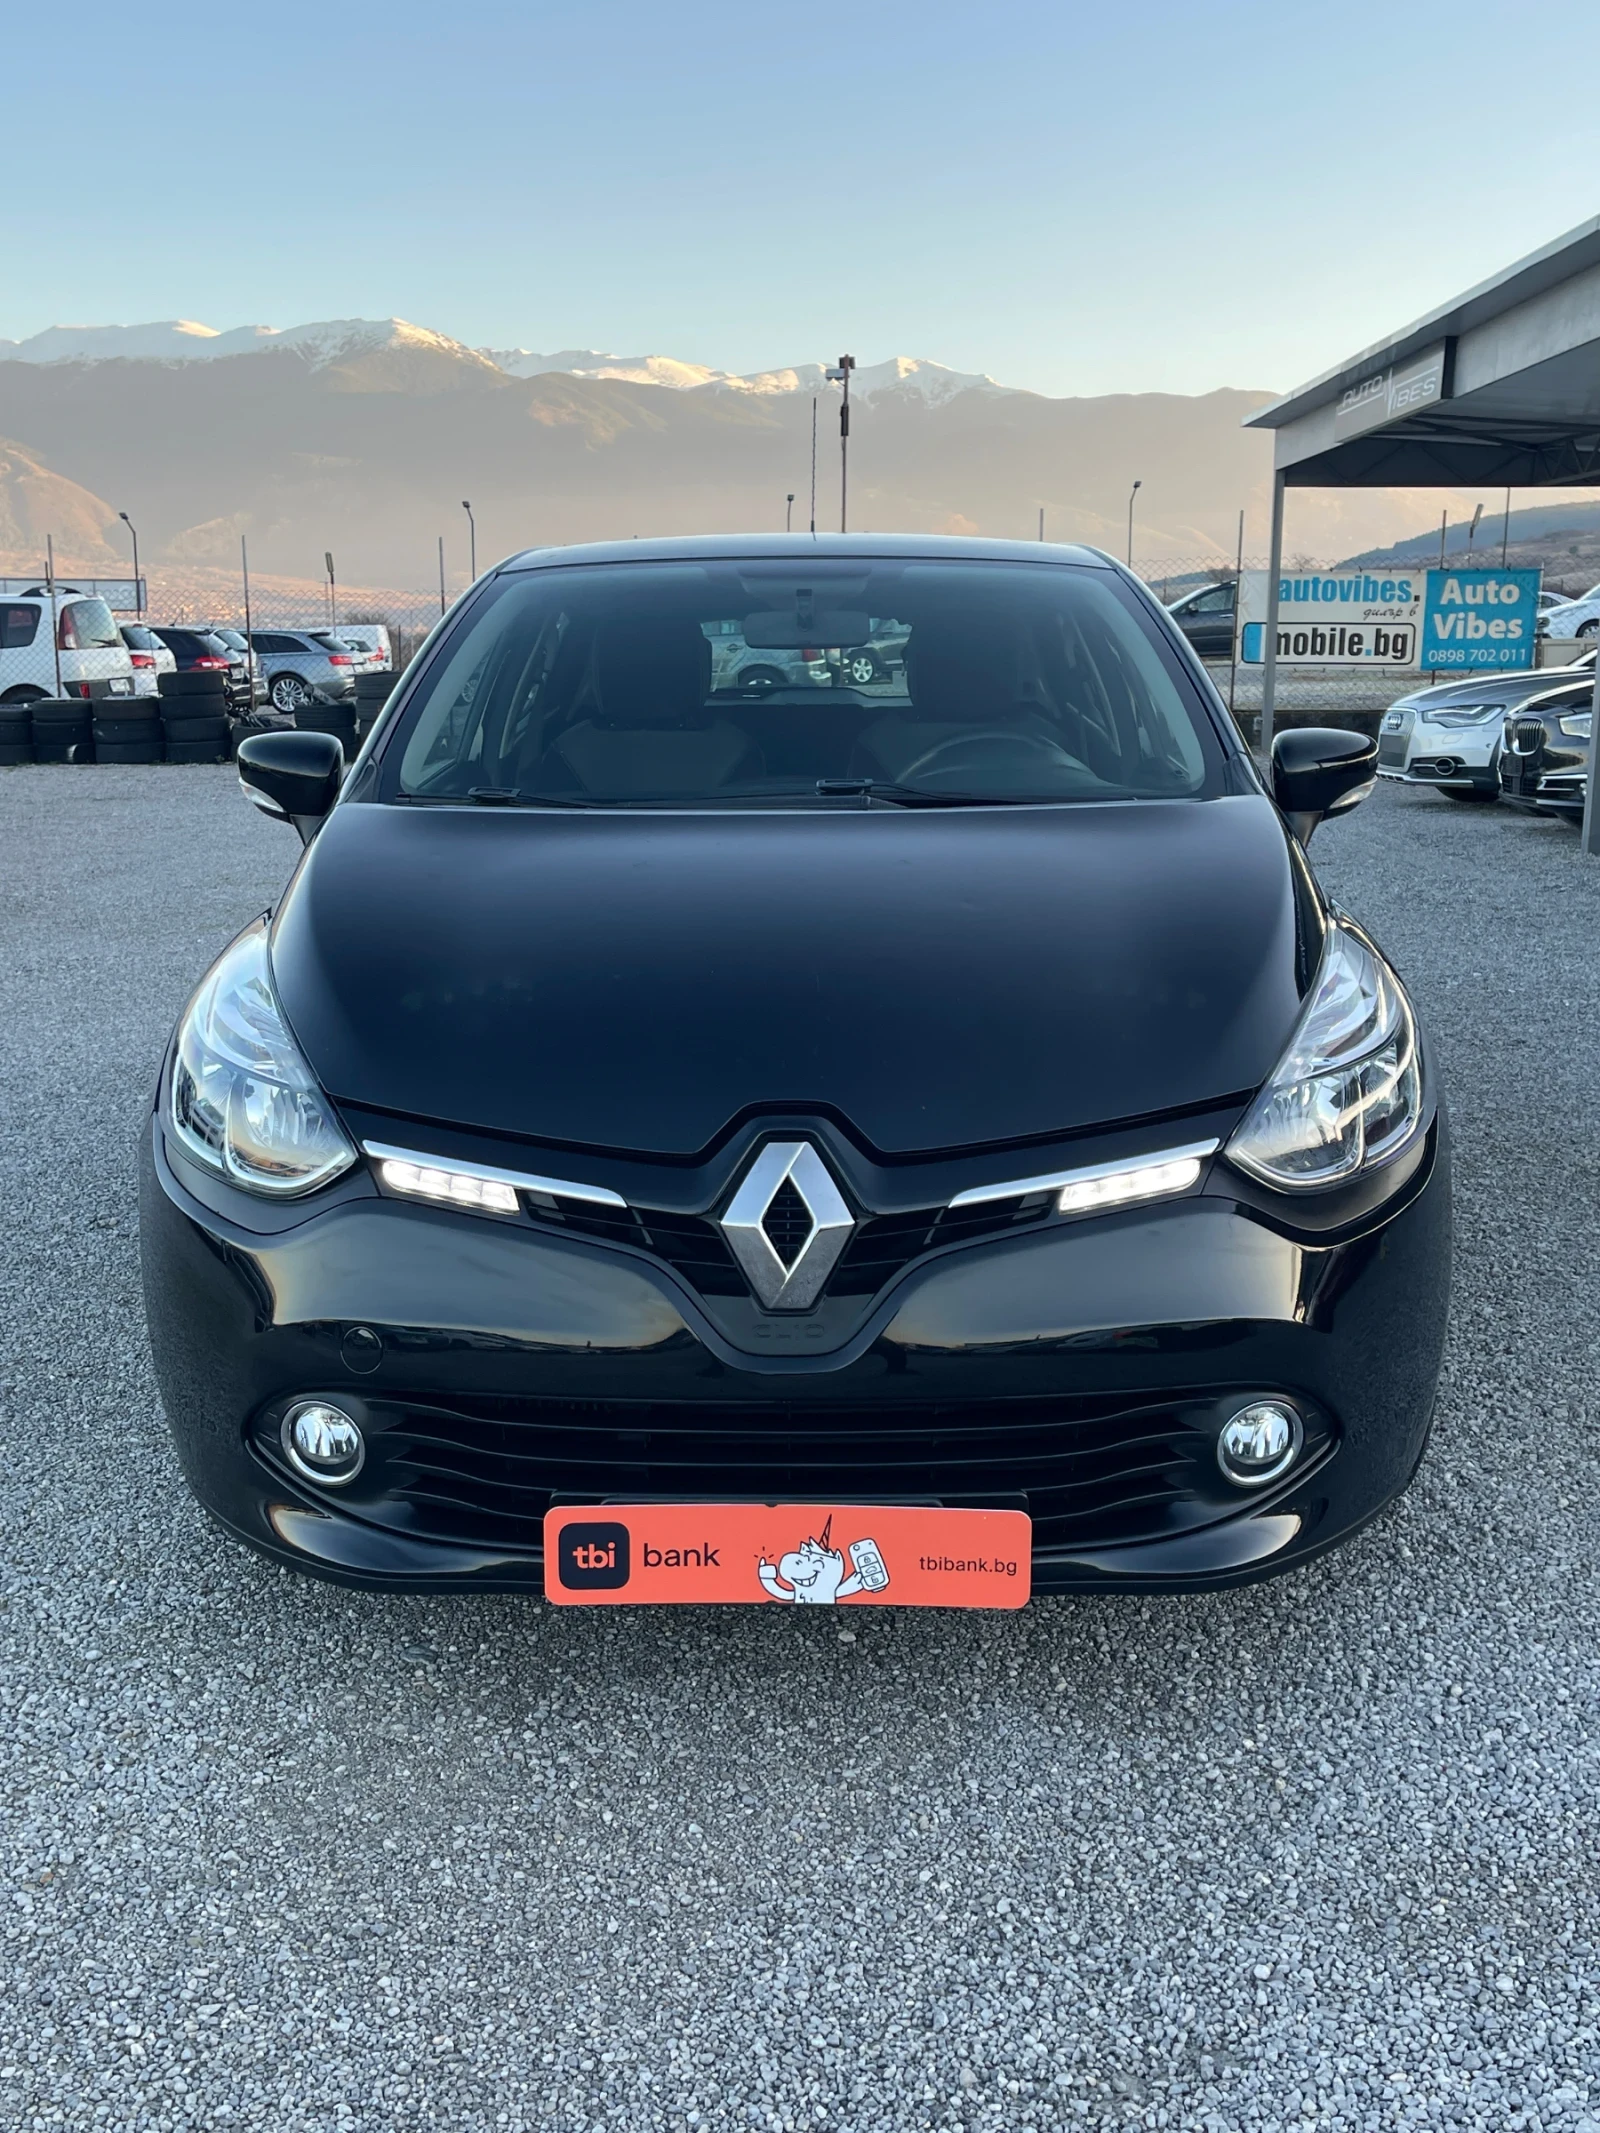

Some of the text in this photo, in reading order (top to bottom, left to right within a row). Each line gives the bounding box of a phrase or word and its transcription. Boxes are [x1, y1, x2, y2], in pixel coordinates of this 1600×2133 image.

[1342, 375, 1383, 407] AUTO
[1440, 578, 1520, 605] Auto
[1433, 612, 1523, 640] Vibes
[1428, 649, 1526, 662] 0898 702 011
[573, 1542, 720, 1569] tbi bank
[919, 1556, 1017, 1576] tbibank.bg
